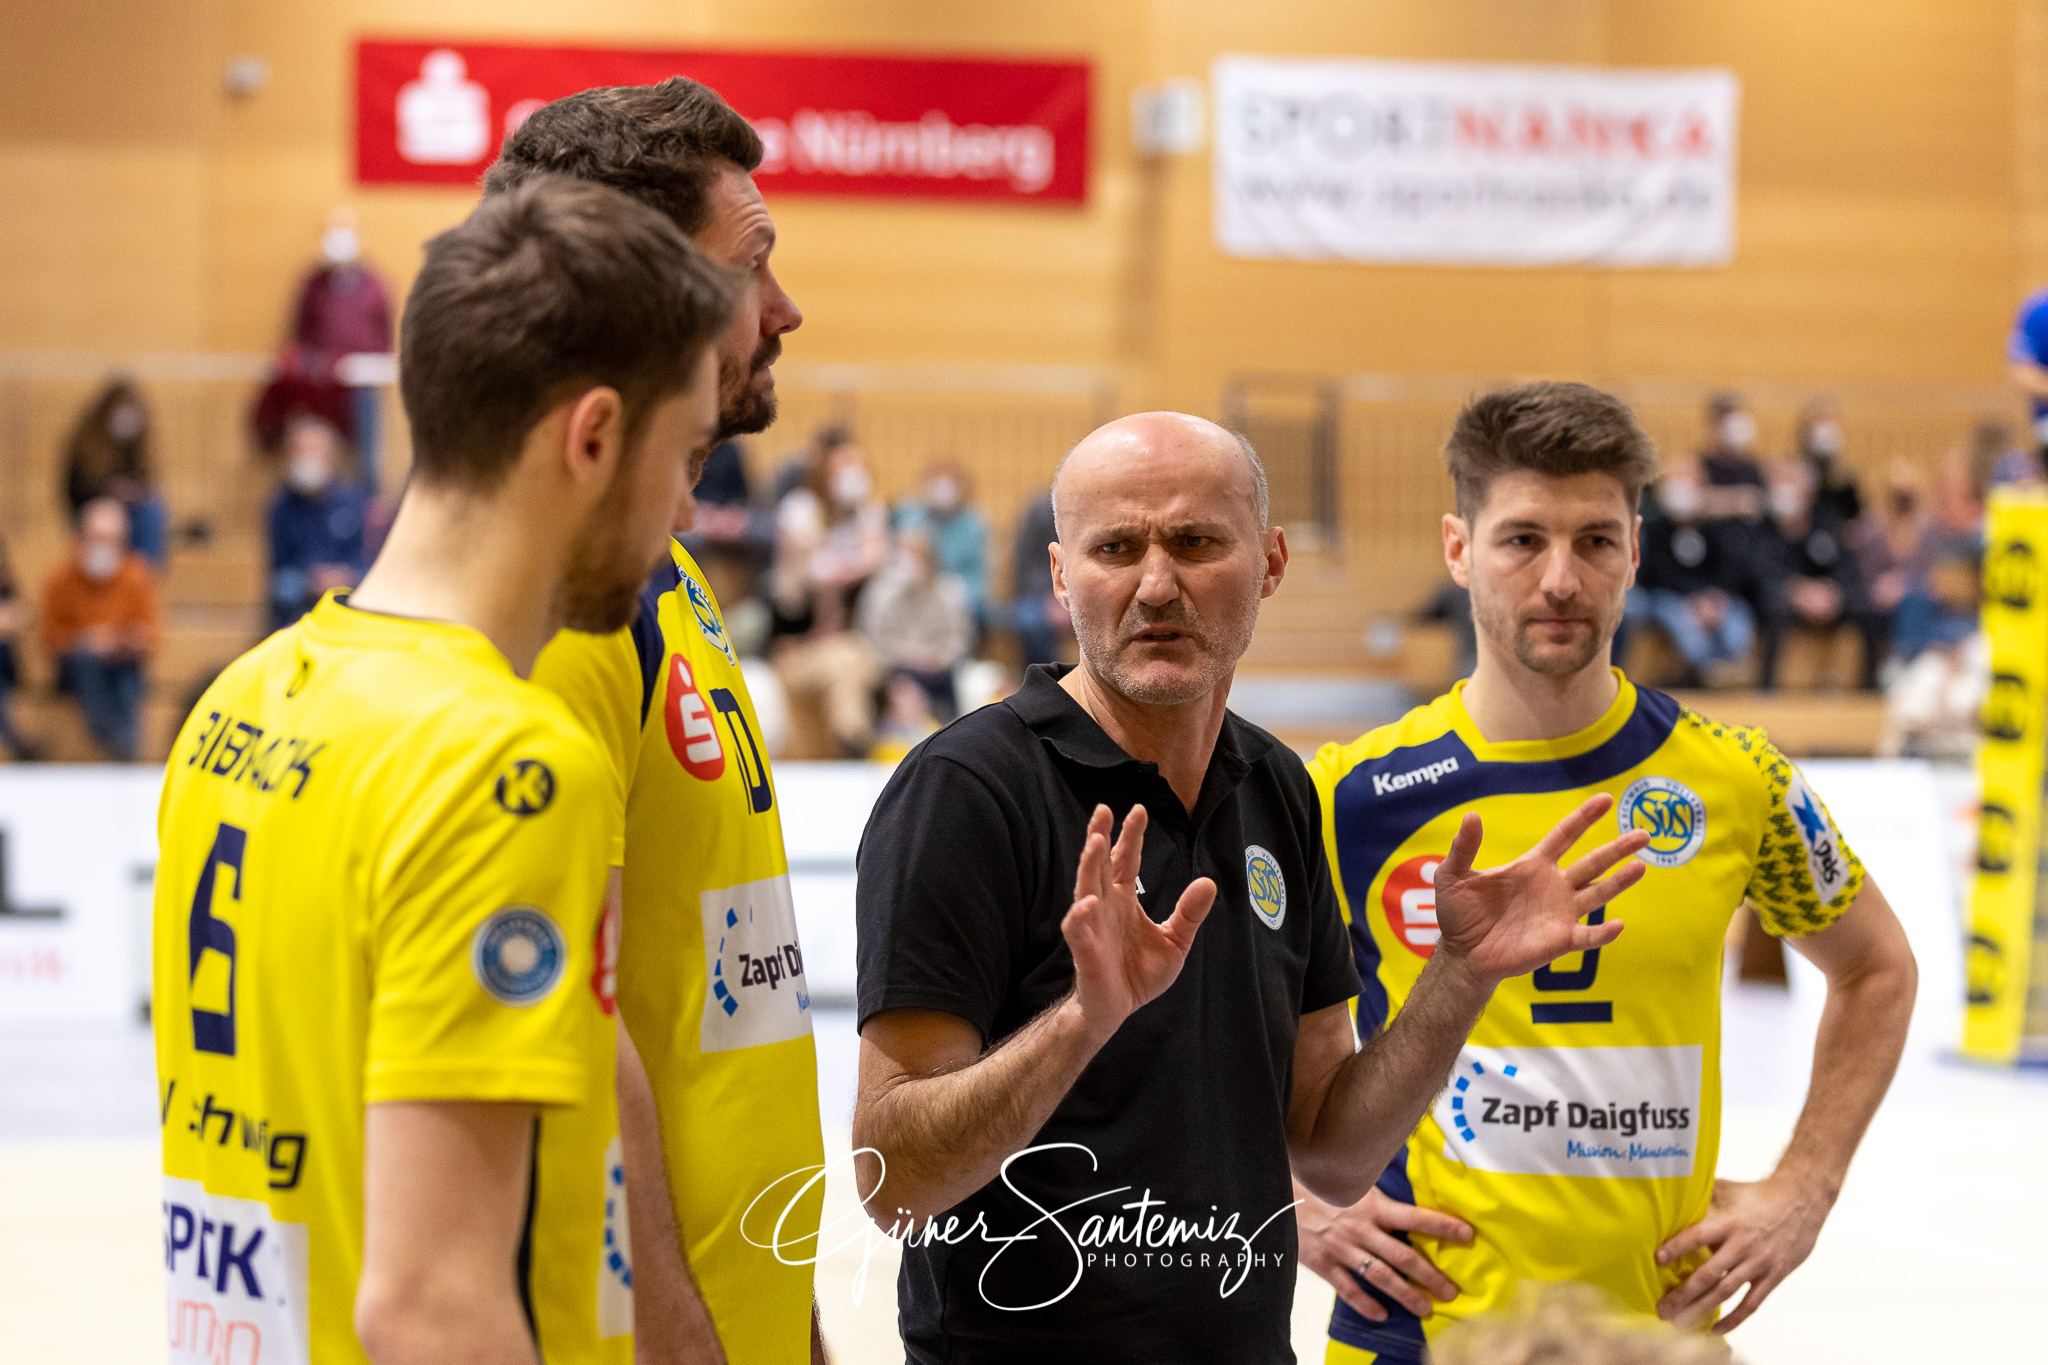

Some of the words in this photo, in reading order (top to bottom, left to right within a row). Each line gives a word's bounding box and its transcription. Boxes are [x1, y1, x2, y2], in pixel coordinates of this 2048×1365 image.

[1372, 756, 1459, 796] Kempa
[189, 822, 247, 1057] 6
[738, 944, 786, 990] Zapf
[1482, 1097, 1558, 1132] Zapf
[1567, 1102, 1690, 1137] Daigfuss
